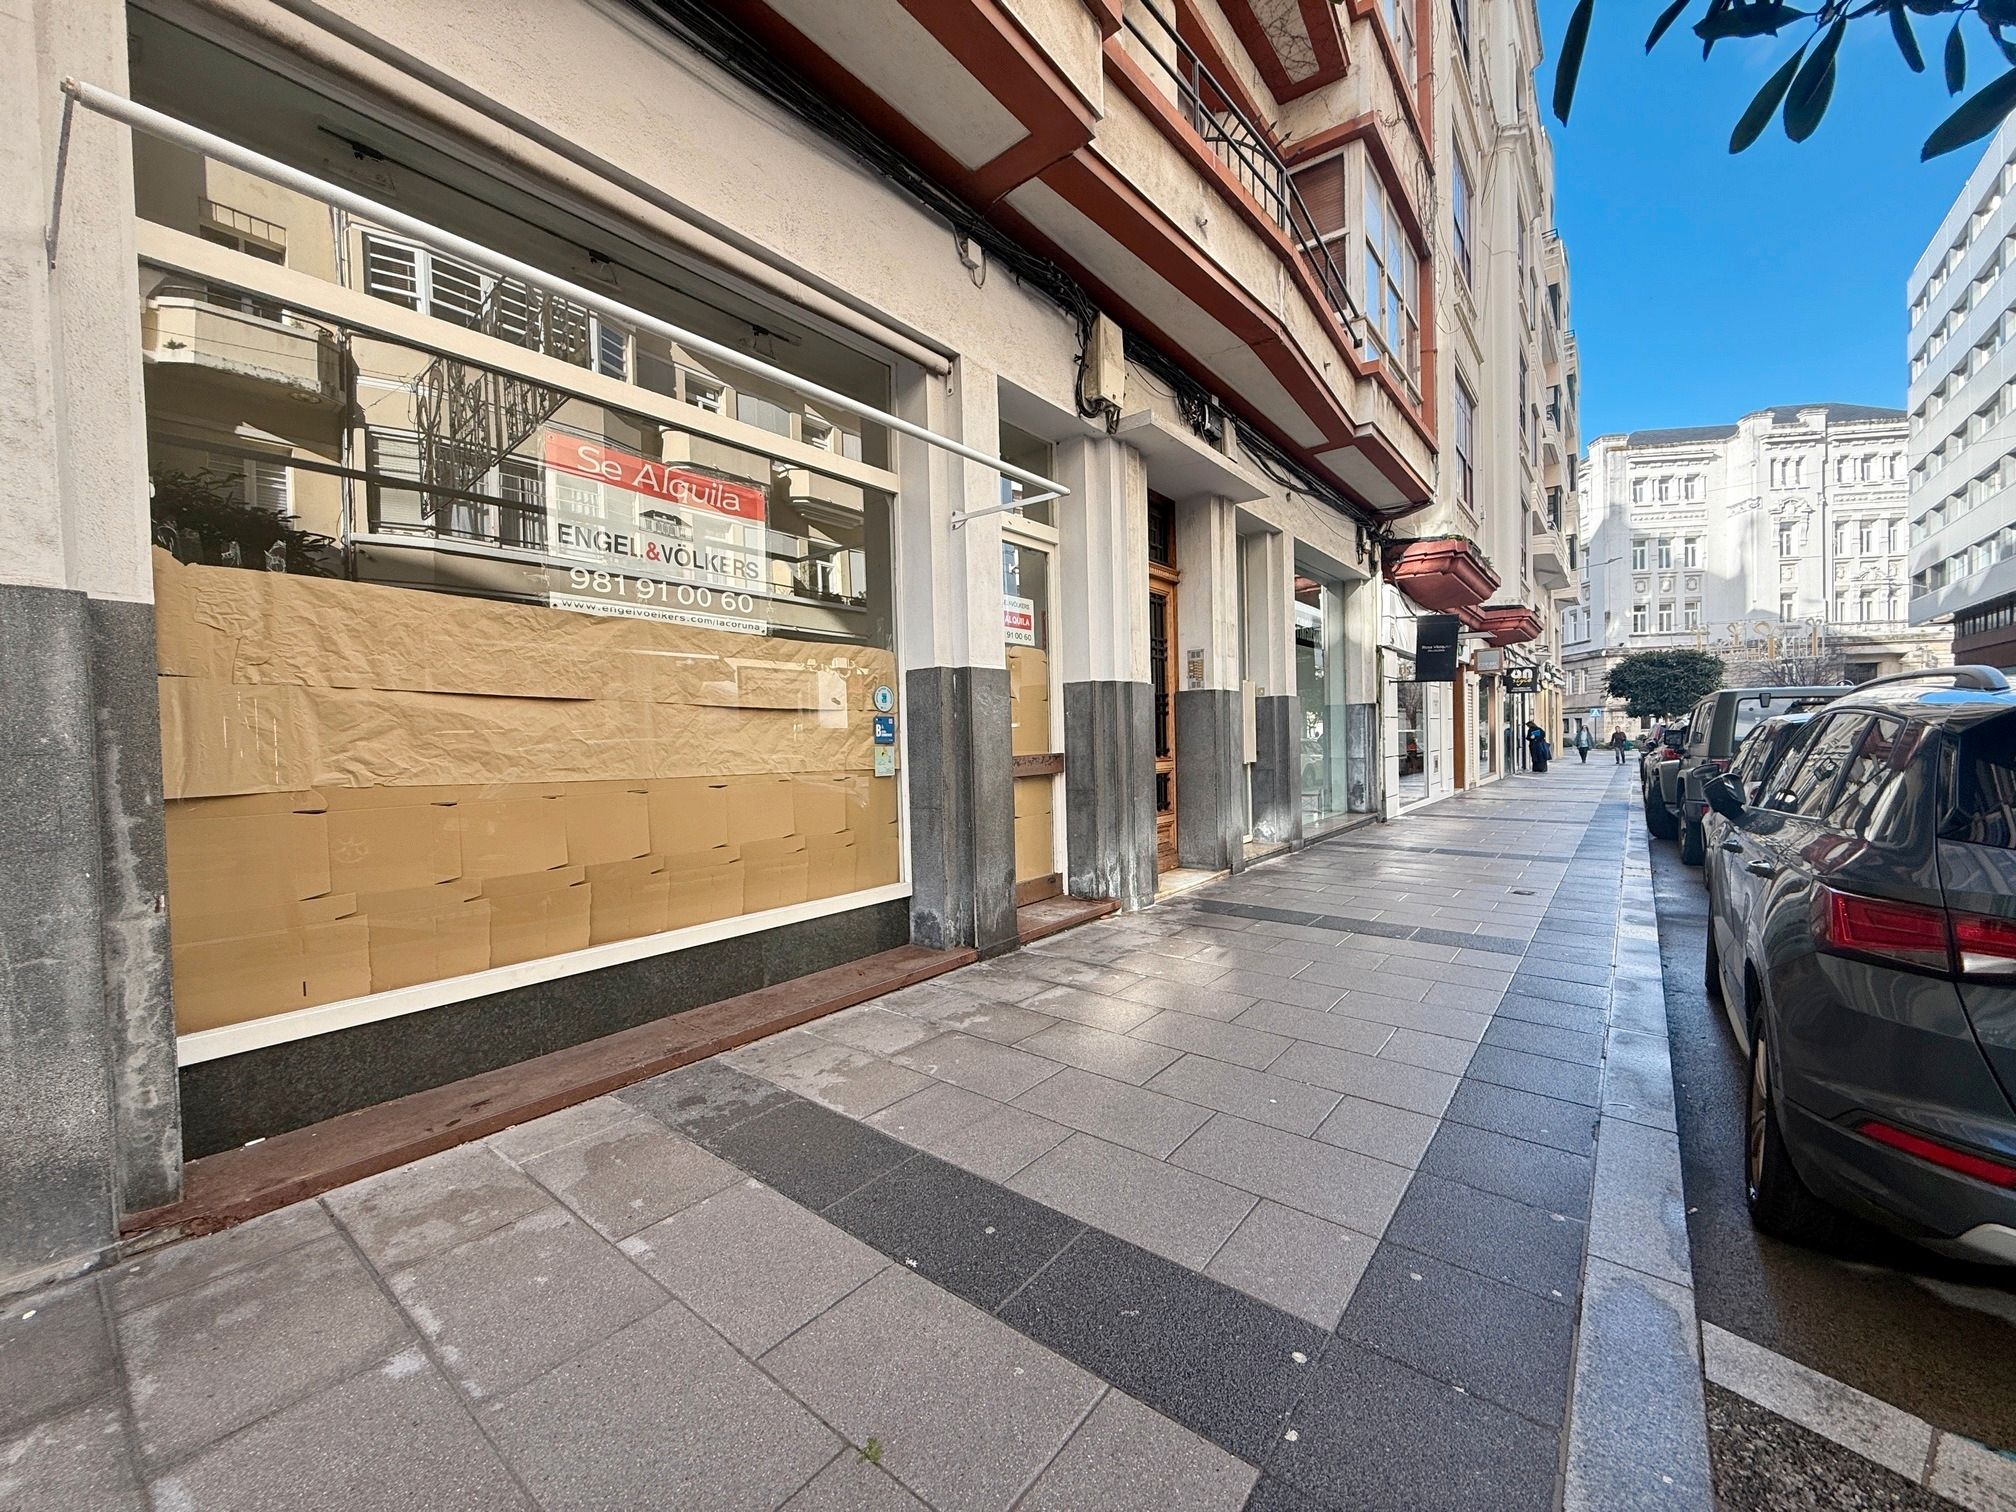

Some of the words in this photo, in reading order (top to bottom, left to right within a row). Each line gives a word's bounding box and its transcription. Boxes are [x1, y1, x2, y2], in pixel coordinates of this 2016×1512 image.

[577, 445, 622, 481] Se
[632, 464, 741, 512] Alquila
[569, 566, 626, 596] 981
[636, 578, 668, 602] 91
[677, 585, 712, 608] 00
[721, 591, 754, 614] 60
